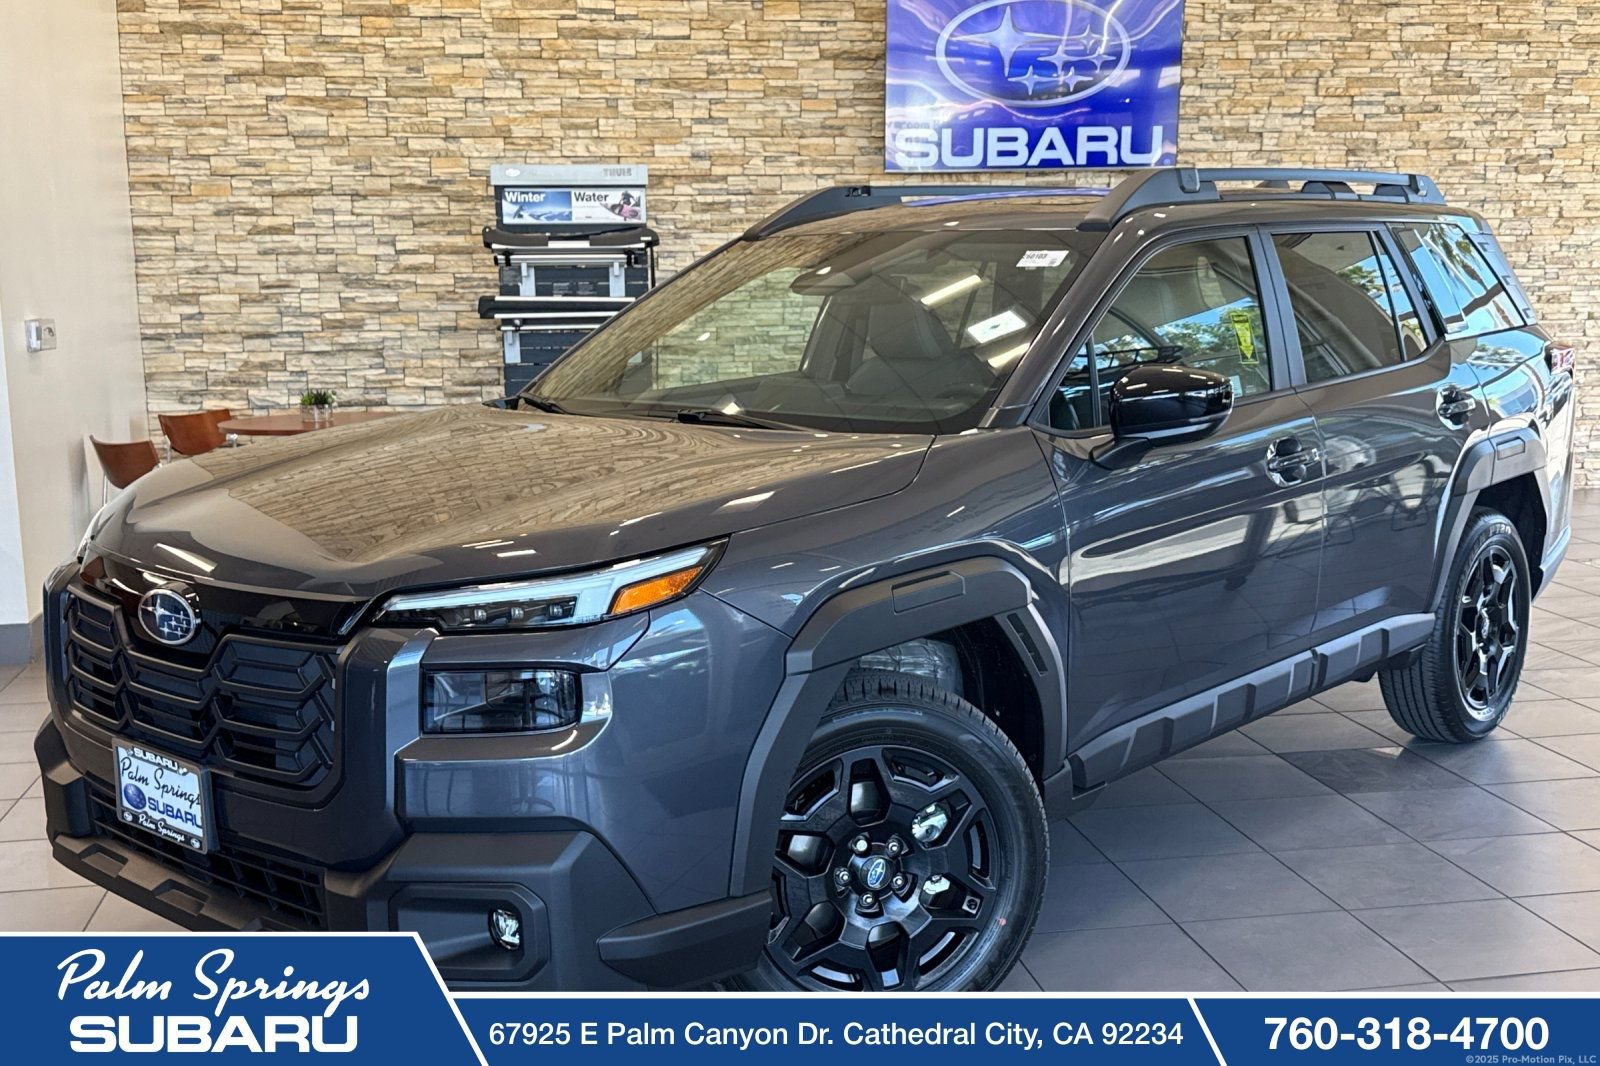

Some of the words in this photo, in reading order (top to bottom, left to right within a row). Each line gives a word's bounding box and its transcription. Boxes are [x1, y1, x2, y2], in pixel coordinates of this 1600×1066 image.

[895, 125, 1163, 168] SUBARU
[505, 191, 546, 203] Winter
[573, 191, 609, 203] Water
[133, 747, 178, 771] SUBARU
[120, 756, 149, 786] Palm
[153, 767, 201, 810] Springs
